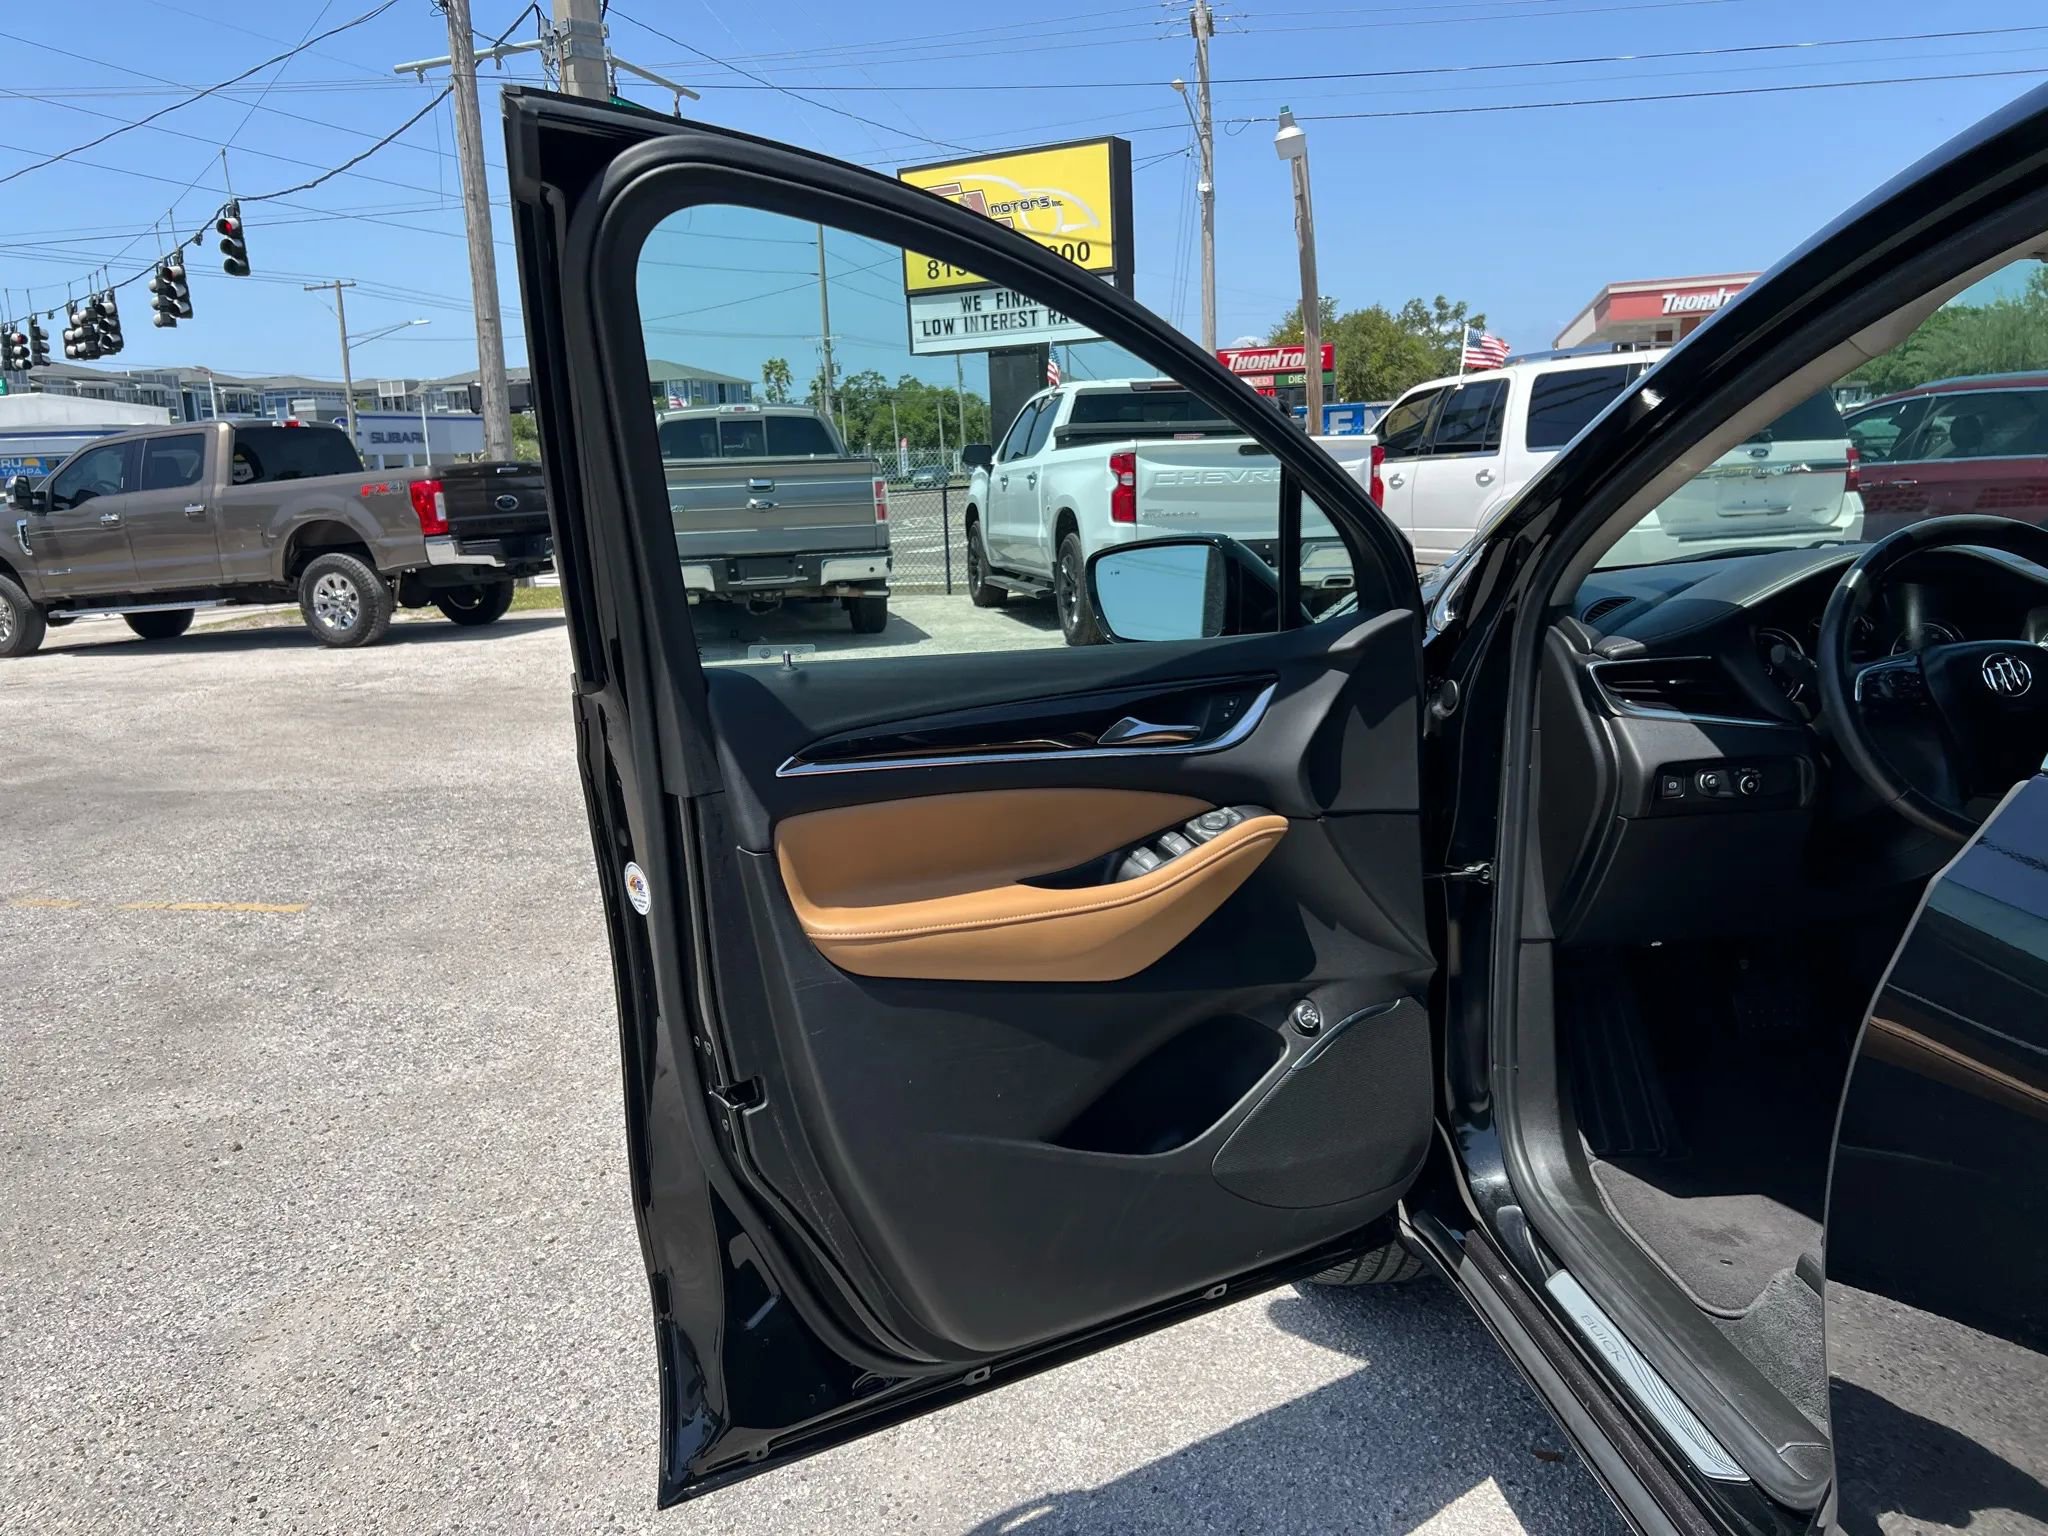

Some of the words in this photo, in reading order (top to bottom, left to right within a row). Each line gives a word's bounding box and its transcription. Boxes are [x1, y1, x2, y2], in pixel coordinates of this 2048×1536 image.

[960, 295, 981, 312] WE
[996, 291, 1037, 309] FINA
[923, 318, 954, 336] LOW
[964, 310, 1038, 333] INTEREST
[371, 432, 431, 444] SUBARU
[3, 467, 42, 476] TAMPA
[1580, 1314, 1626, 1361] BUICK
